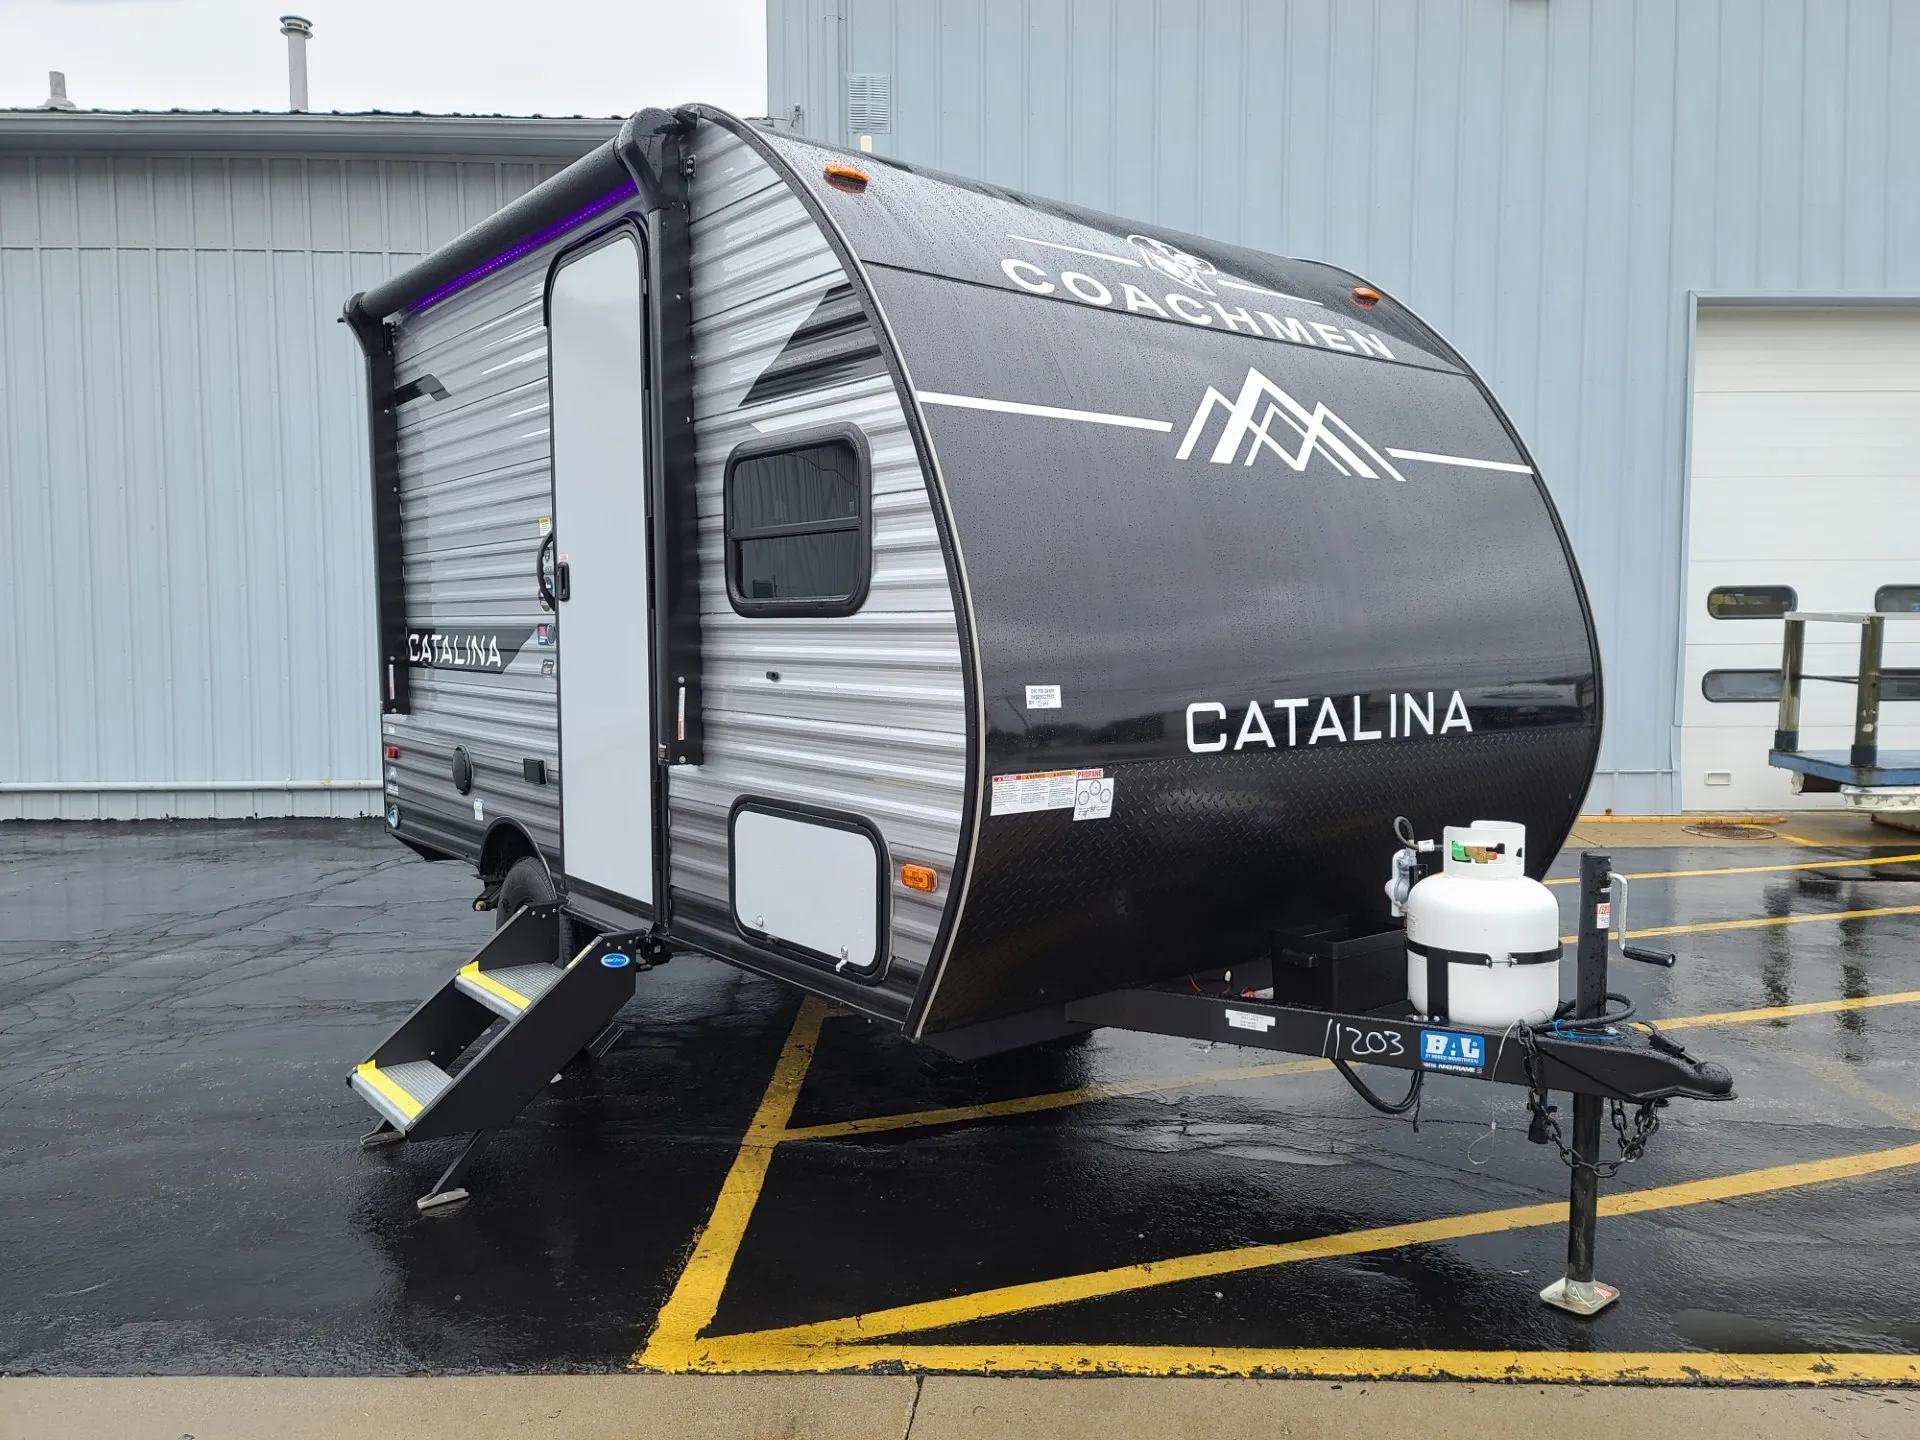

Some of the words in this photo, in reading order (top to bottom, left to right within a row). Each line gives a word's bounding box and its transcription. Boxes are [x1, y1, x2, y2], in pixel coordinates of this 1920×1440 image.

[1000, 258, 1396, 360] COACHMEN
[408, 634, 502, 667] CATALINA
[1186, 690, 1473, 754] CATALINA
[1077, 769, 1103, 779] PROPANE
